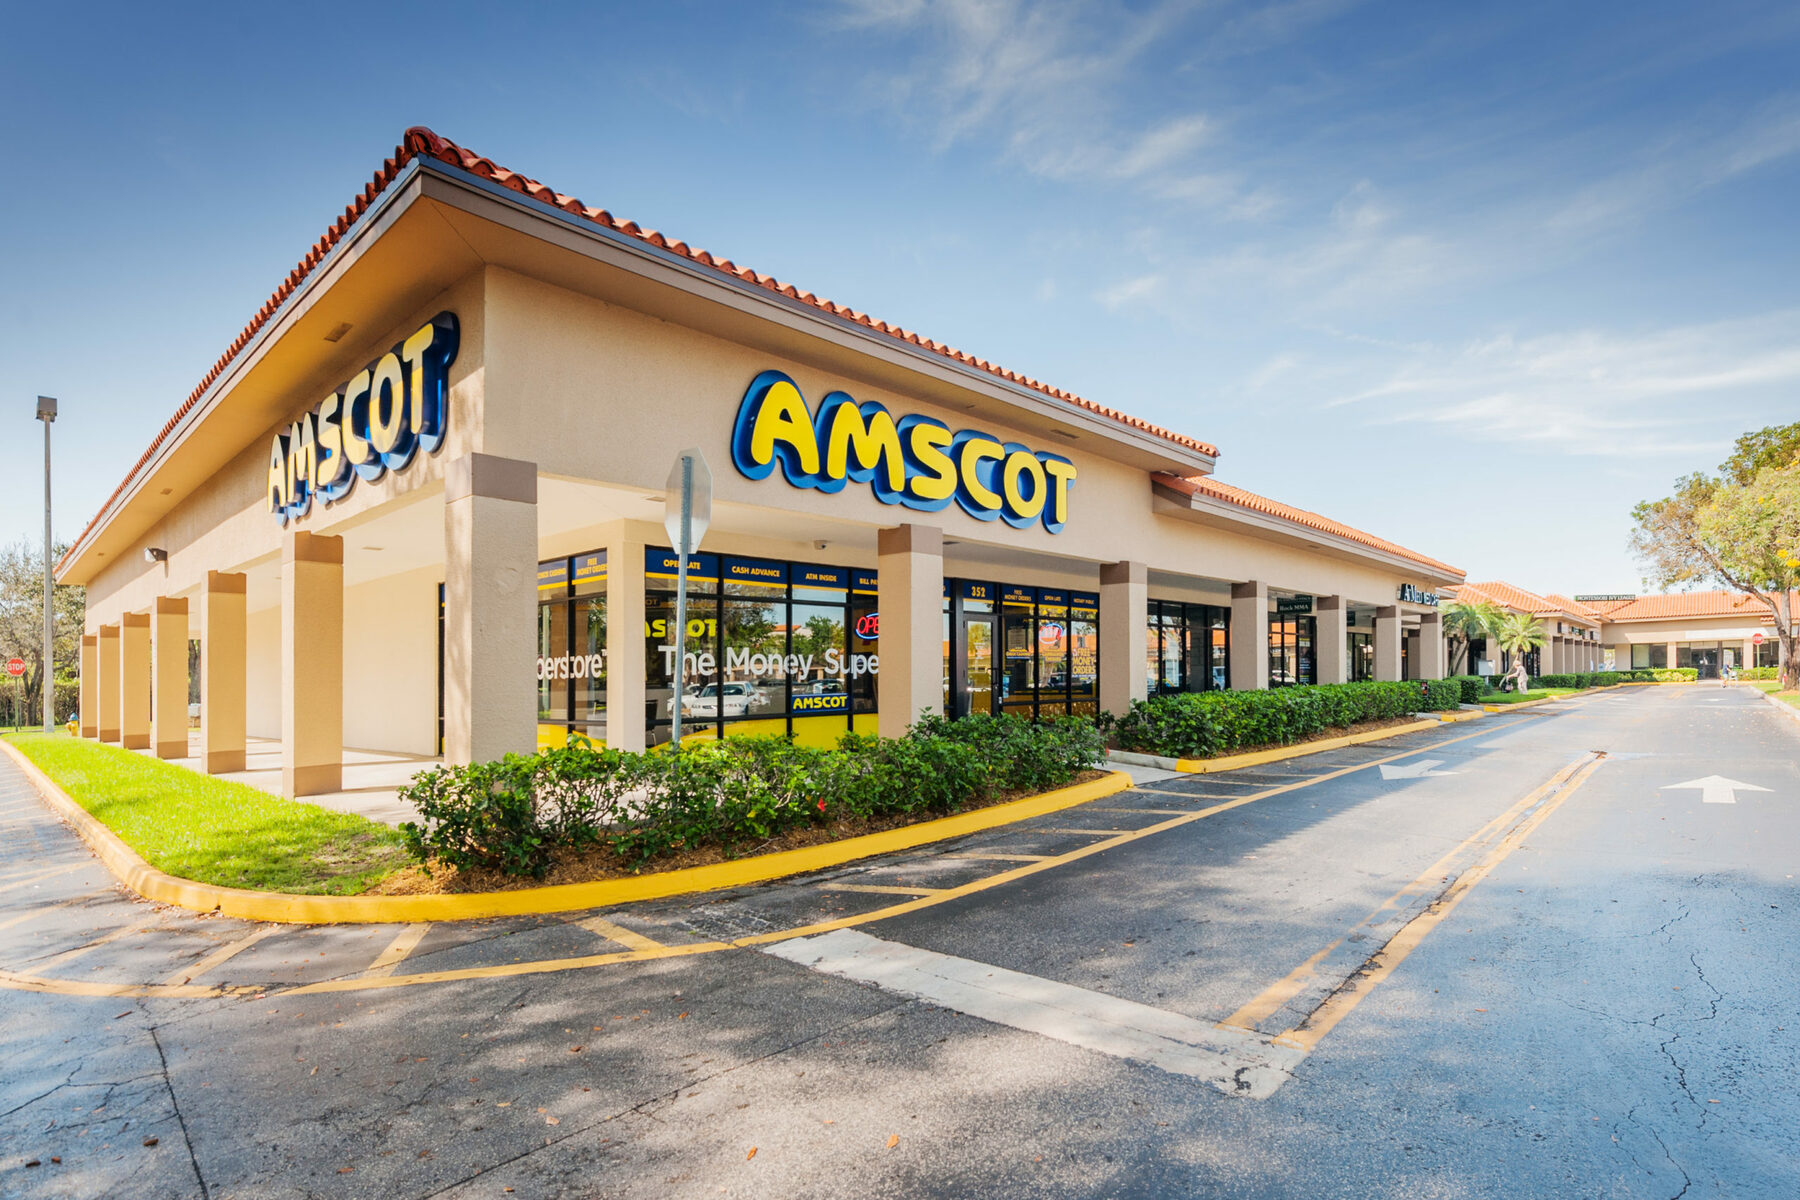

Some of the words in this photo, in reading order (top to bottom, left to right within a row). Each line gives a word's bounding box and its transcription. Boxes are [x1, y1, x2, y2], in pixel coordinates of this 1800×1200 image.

[268, 322, 435, 514] AMSCOT
[751, 380, 1077, 524] AMSCOT
[663, 559, 680, 568] OPE
[731, 565, 750, 575] CASH
[750, 567, 780, 577] ADVANCE
[819, 574, 837, 582] INSIDE
[971, 586, 986, 597] 352
[726, 646, 814, 680] Money
[1072, 656, 1096, 666] MONEY
[7, 663, 25, 671] STOP
[1072, 665, 1097, 675] ORDERS
[793, 696, 849, 710] AMSCOT
